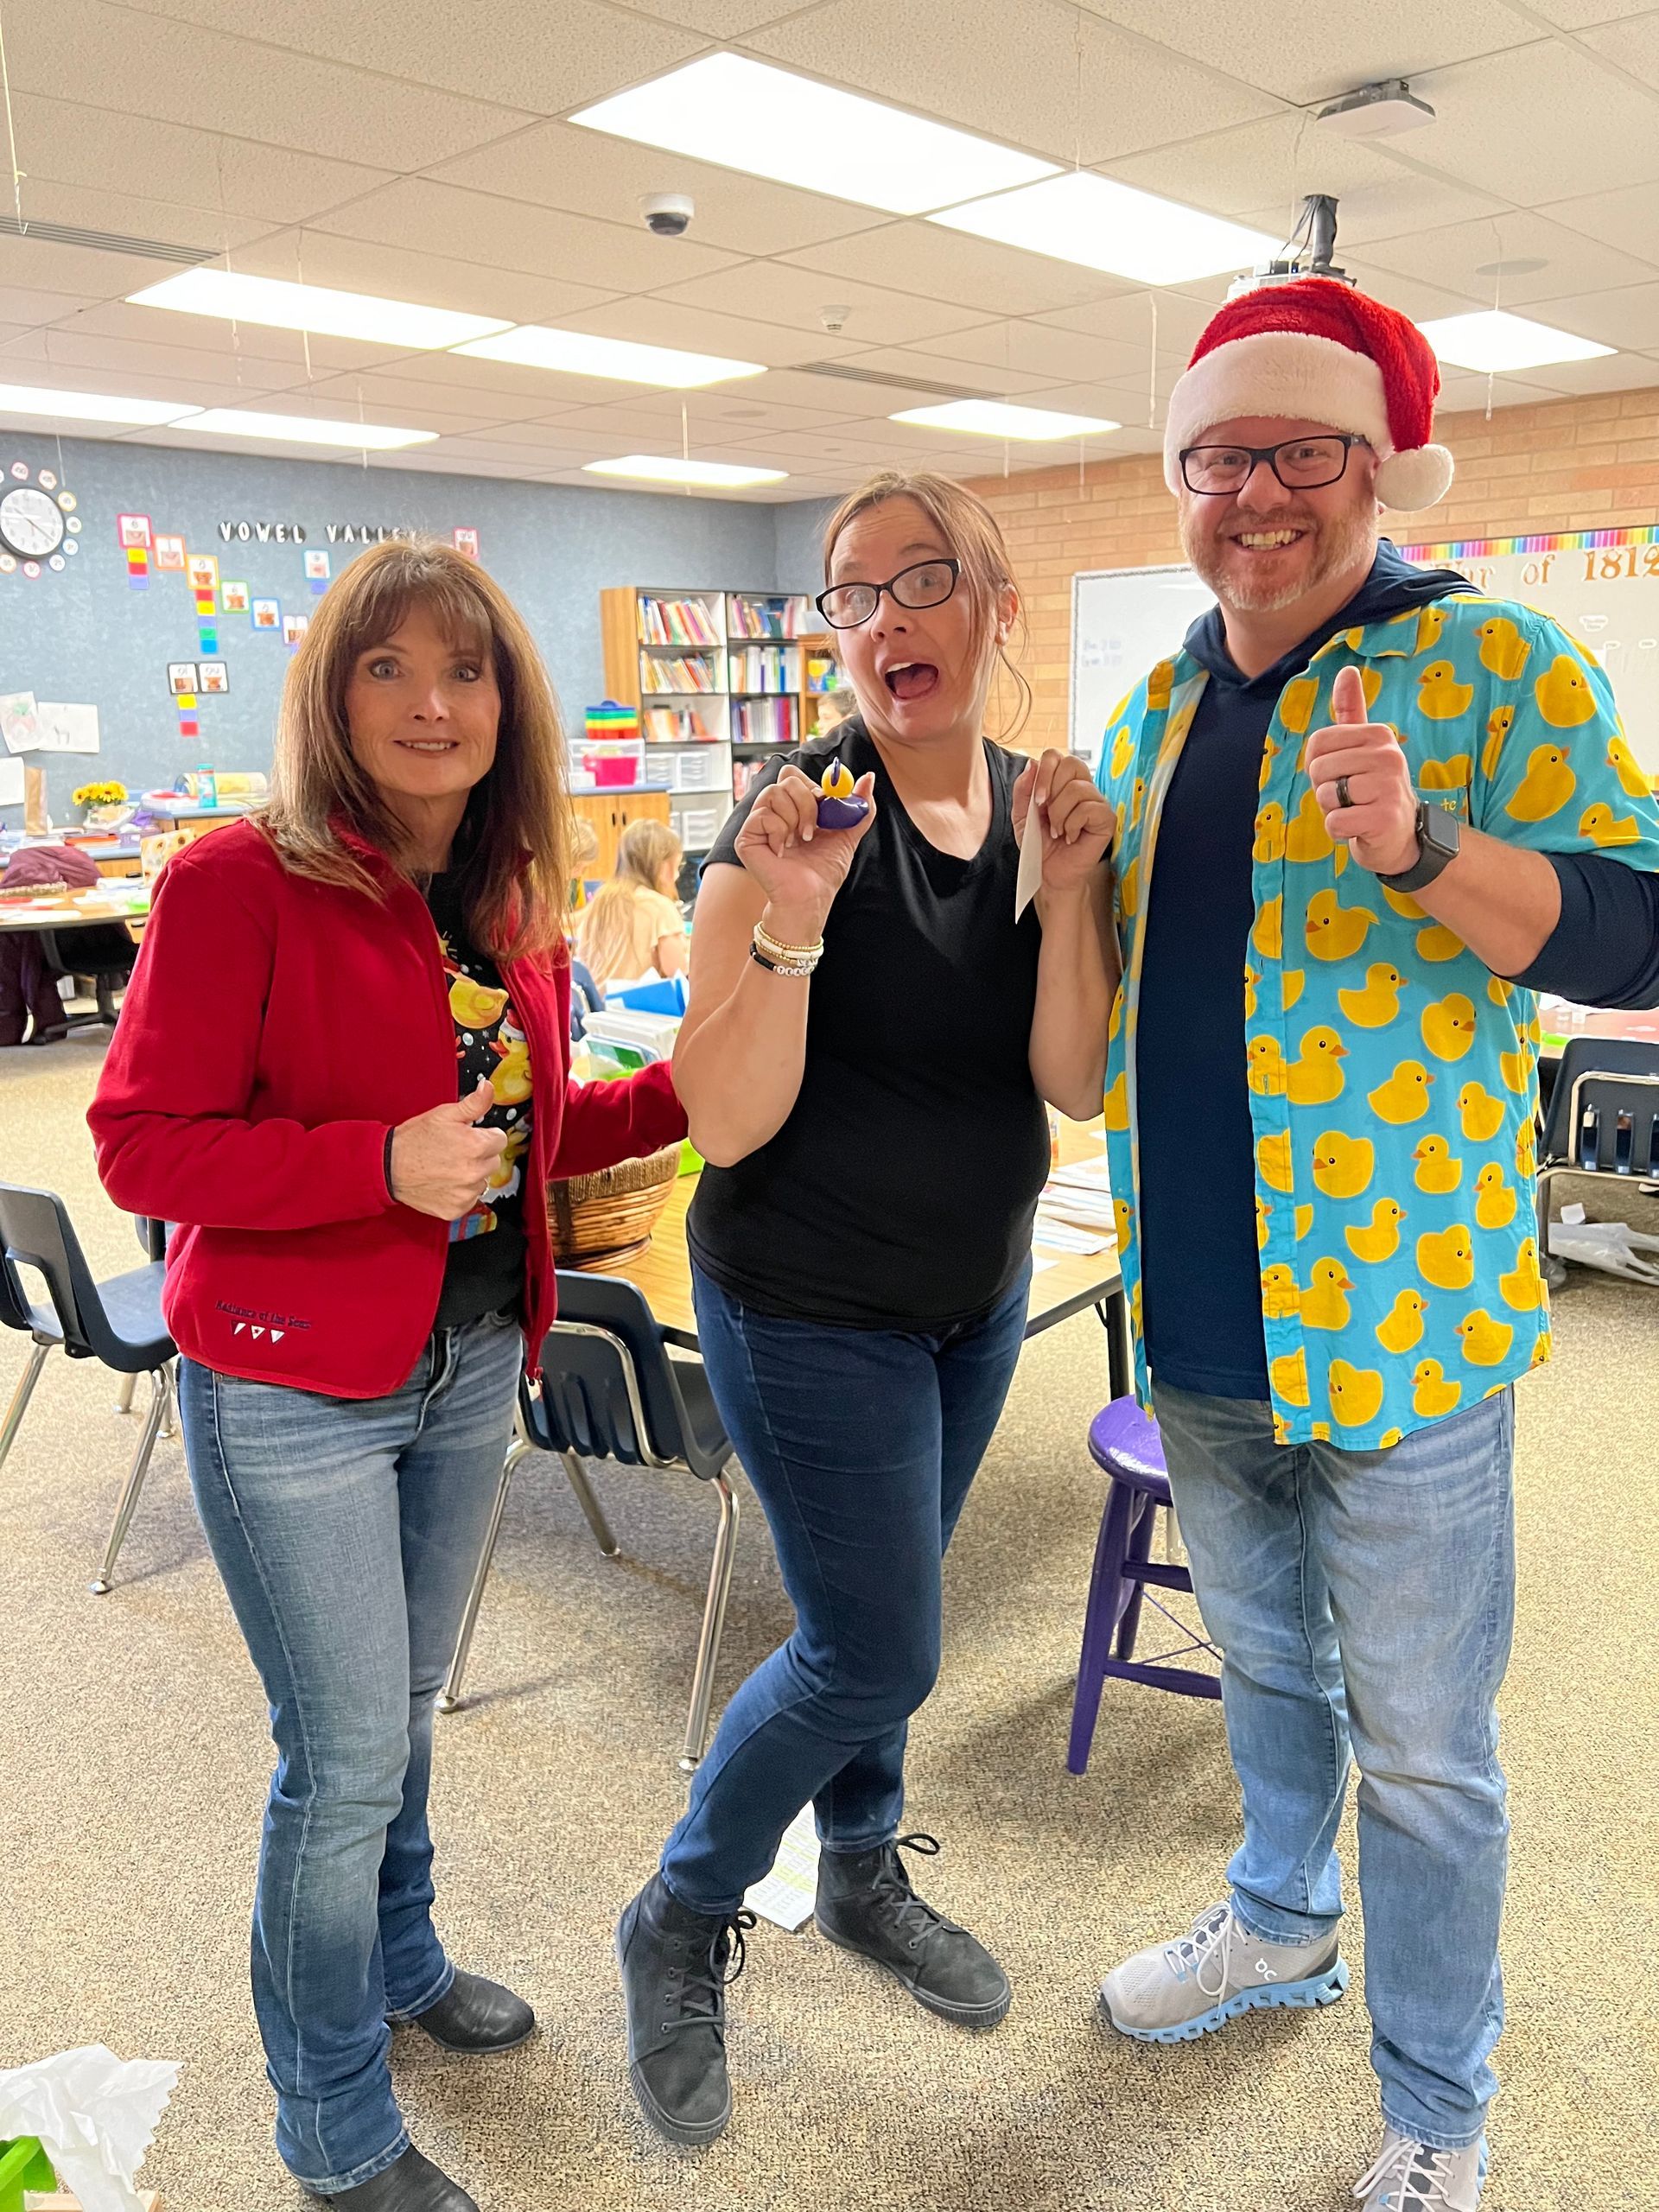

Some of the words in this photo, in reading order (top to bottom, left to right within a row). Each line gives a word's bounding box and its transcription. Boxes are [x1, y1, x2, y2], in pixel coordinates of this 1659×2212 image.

[219, 521, 304, 544] VOWEL
[1523, 555, 1554, 584] of
[1583, 544, 1659, 582] 1812
